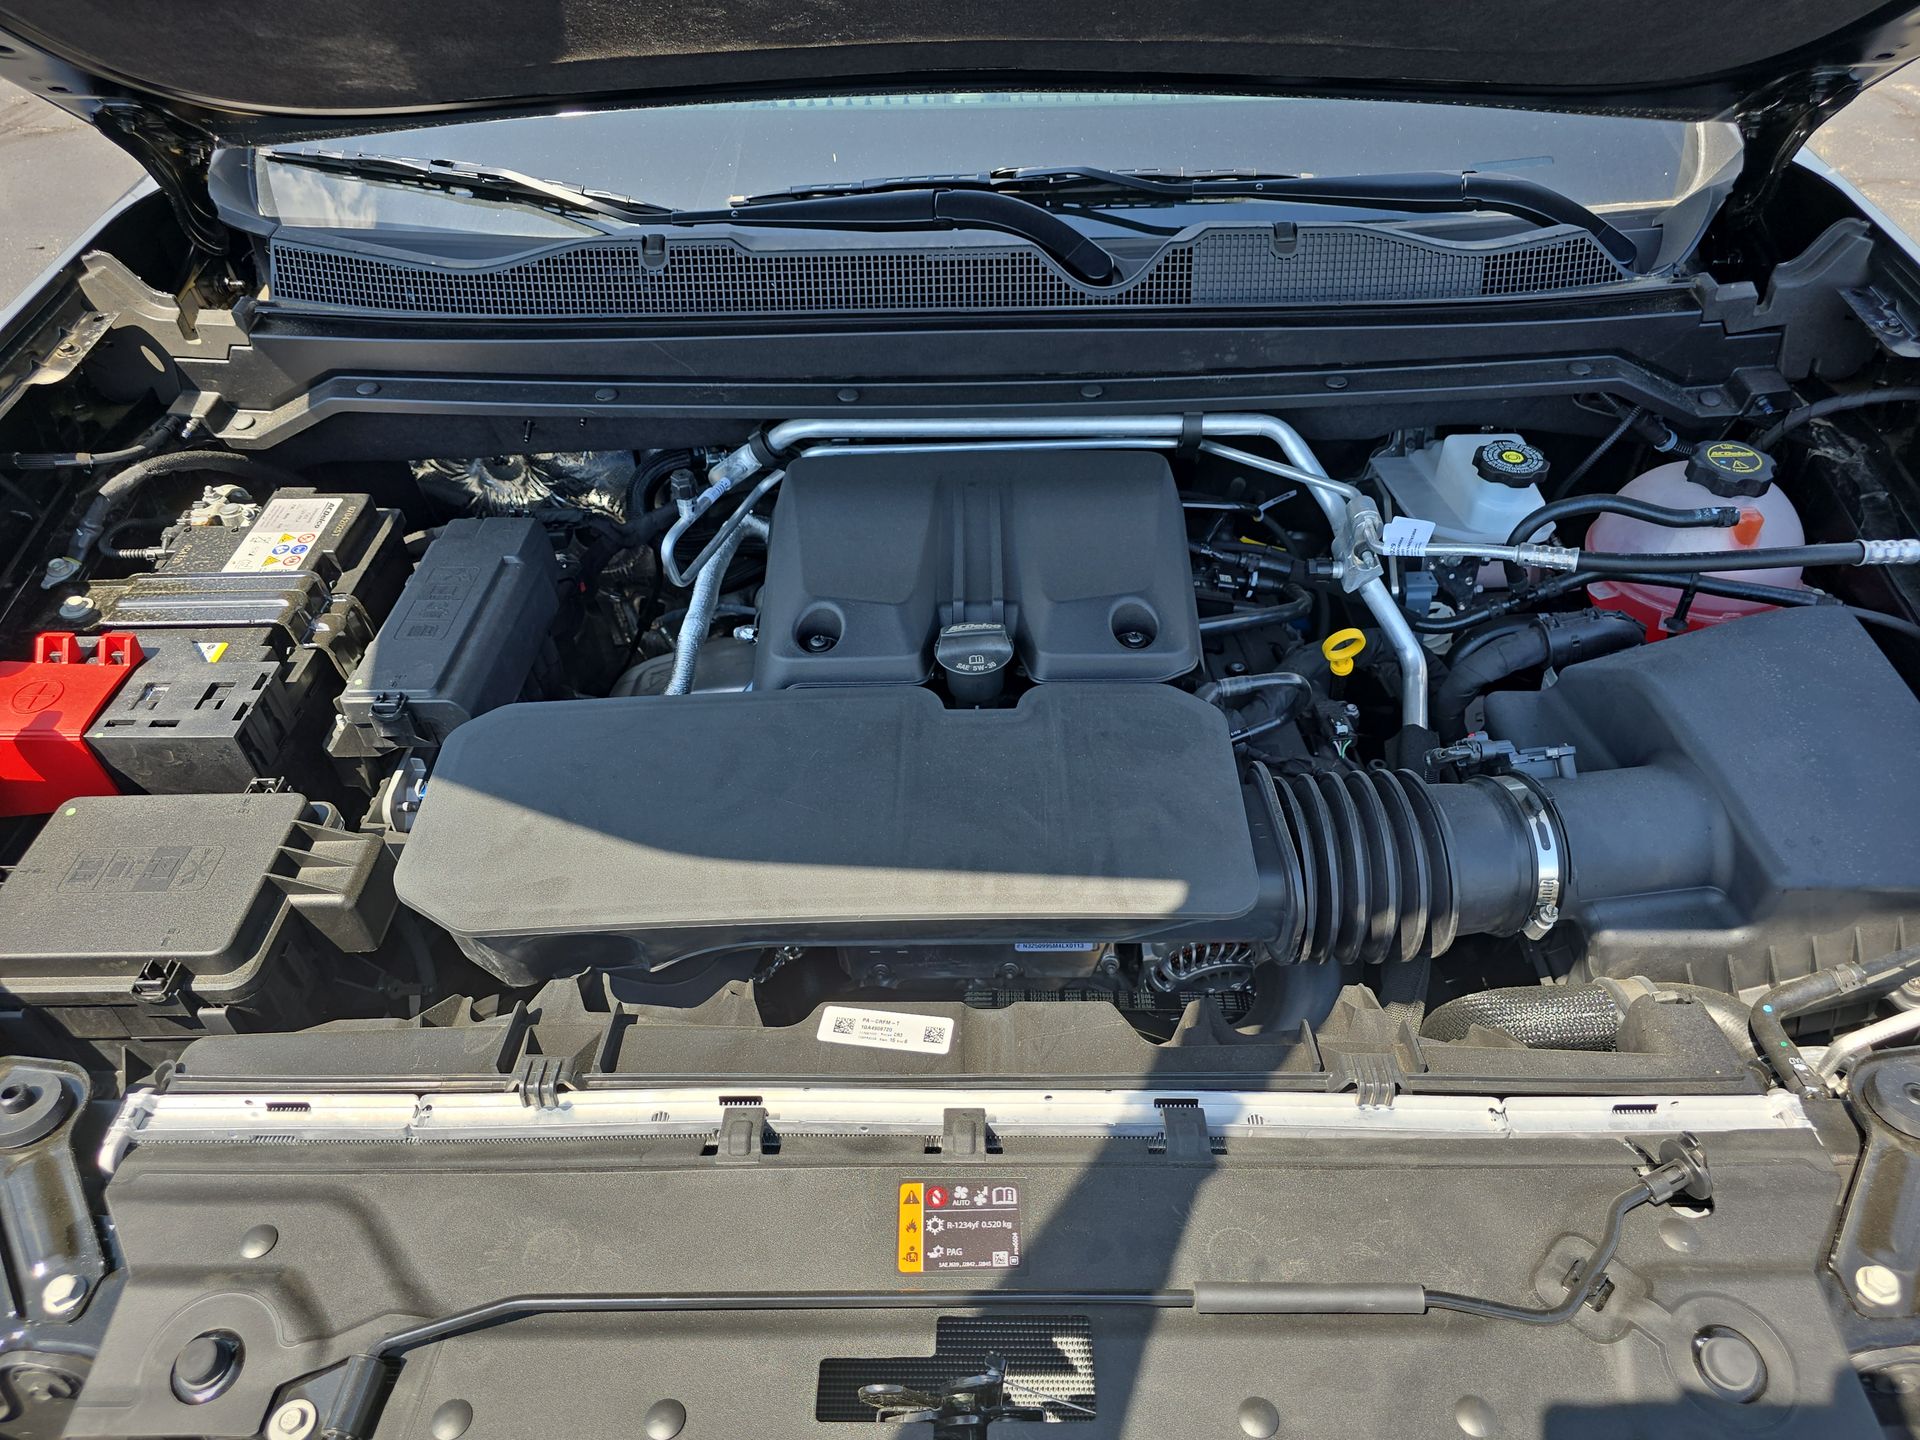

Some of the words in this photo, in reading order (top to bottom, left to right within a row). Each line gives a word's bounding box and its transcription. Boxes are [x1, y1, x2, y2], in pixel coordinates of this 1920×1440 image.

[314, 502, 335, 528] ACDelco
[956, 663, 970, 671] SAE
[972, 661, 996, 671] 5W-30
[947, 1221, 979, 1230] R-1234yf
[1002, 1219, 1012, 1229] kg
[946, 1248, 963, 1256] PAG
